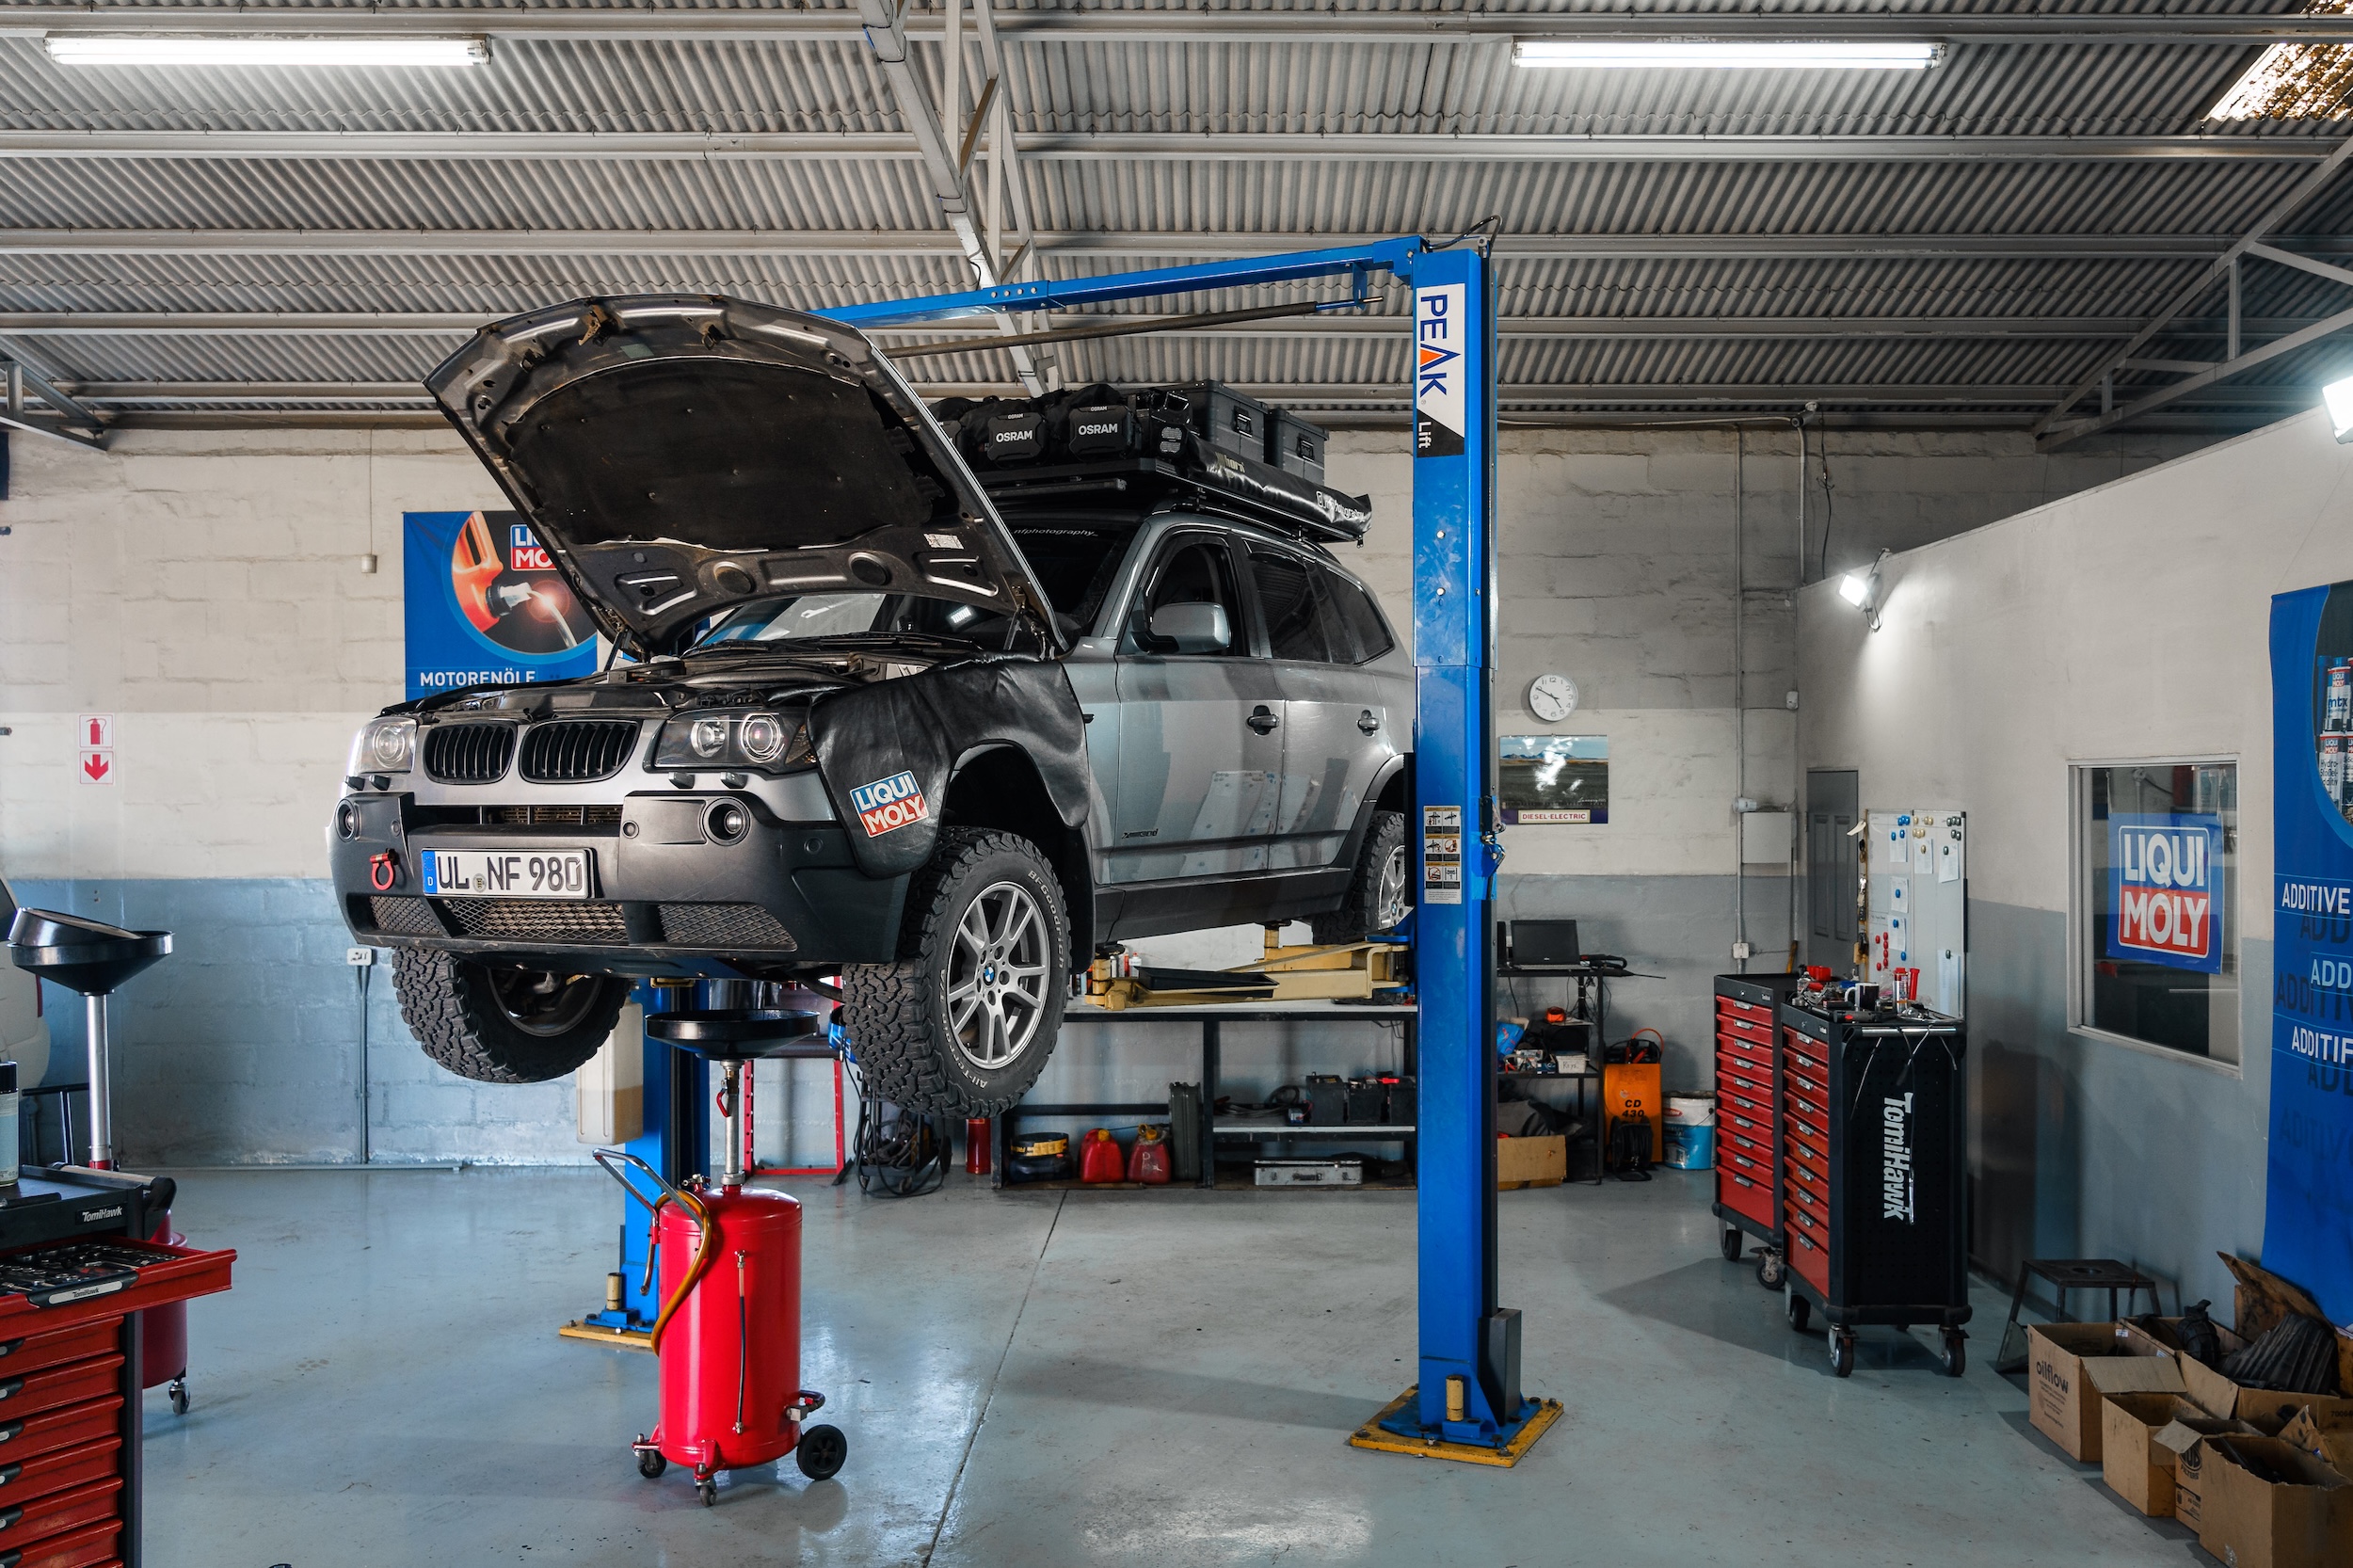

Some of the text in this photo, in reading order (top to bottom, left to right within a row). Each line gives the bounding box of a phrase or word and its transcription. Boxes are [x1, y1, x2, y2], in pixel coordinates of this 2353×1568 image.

[1418, 294, 1462, 449] PEAK Lift
[996, 430, 1033, 443] OSRAM
[1078, 423, 1118, 436] OSRAM
[855, 775, 916, 811] LIQUI
[864, 795, 923, 833] MOLY
[438, 856, 583, 891] UL NF 980
[2123, 833, 2204, 888] LIQUI
[427, 876, 434, 887] D
[2281, 882, 2350, 915] ADDITIVE
[1027, 870, 1064, 969] BFGoodrich
[2123, 890, 2208, 949] MOLY
[1622, 1109, 1644, 1117] 430
[1625, 1099, 1641, 1108] CD
[1883, 1092, 1914, 1221] TomiHawk
[82, 1206, 122, 1223] TomiHawk
[72, 1287, 100, 1298] TomiHawk
[2036, 1359, 2069, 1394] oilflow
